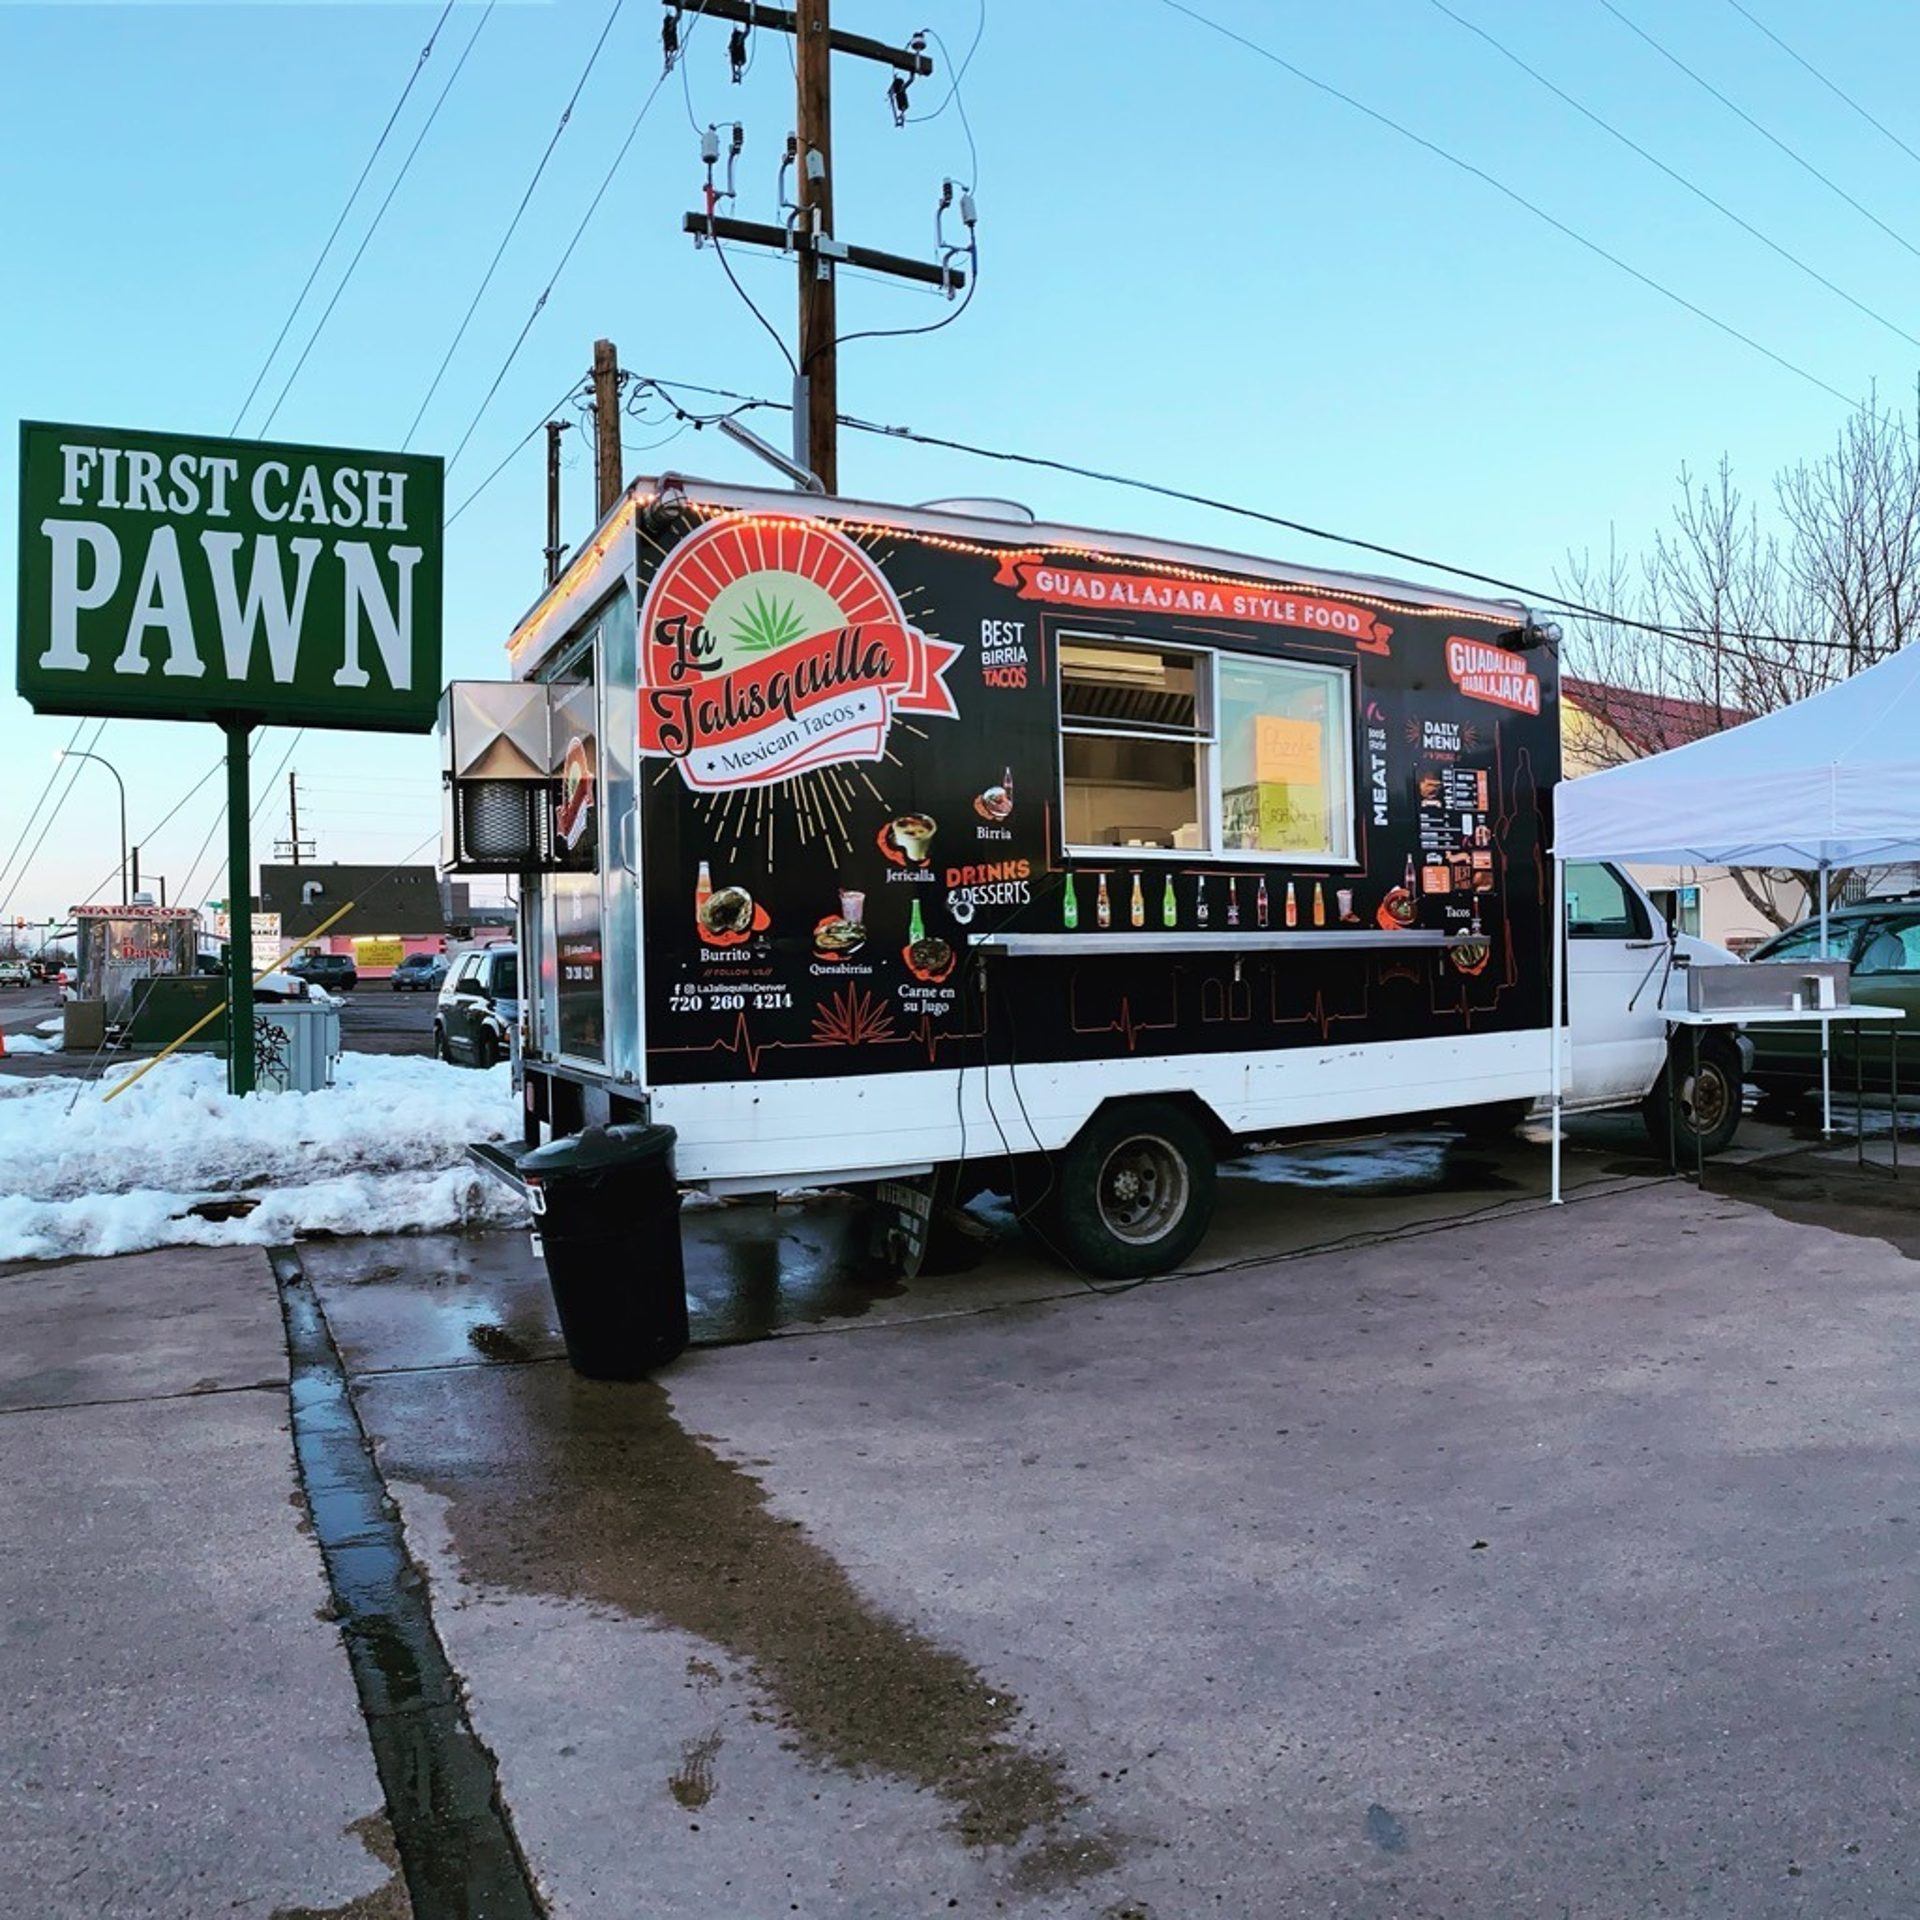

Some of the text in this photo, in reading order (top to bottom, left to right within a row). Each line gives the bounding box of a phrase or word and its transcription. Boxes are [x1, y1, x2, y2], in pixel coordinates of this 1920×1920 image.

[59, 444, 408, 531] FIRST CASH
[39, 518, 424, 690] PAWN
[1035, 570, 1361, 632] GUADALAJARA STYLE FOOD
[981, 620, 1025, 648] BEST
[654, 615, 723, 681] La
[981, 647, 1028, 665] BIRRIA
[982, 668, 1028, 688] TACOS
[1424, 721, 1460, 736] DAILY
[721, 706, 856, 772] Mexican Tacos
[1423, 734, 1461, 751] MENU
[1371, 755, 1388, 826] MEAT
[976, 827, 1012, 840] Birria
[886, 869, 935, 883] Jericalla
[946, 859, 1031, 887] DRINKS
[963, 881, 1031, 904] DESSERTS
[700, 948, 751, 962] Burrito
[809, 963, 873, 975] Quesabirrias
[898, 985, 956, 999] Carne en
[669, 993, 794, 1012] 720 260 4214
[904, 999, 950, 1016] su Jugo
